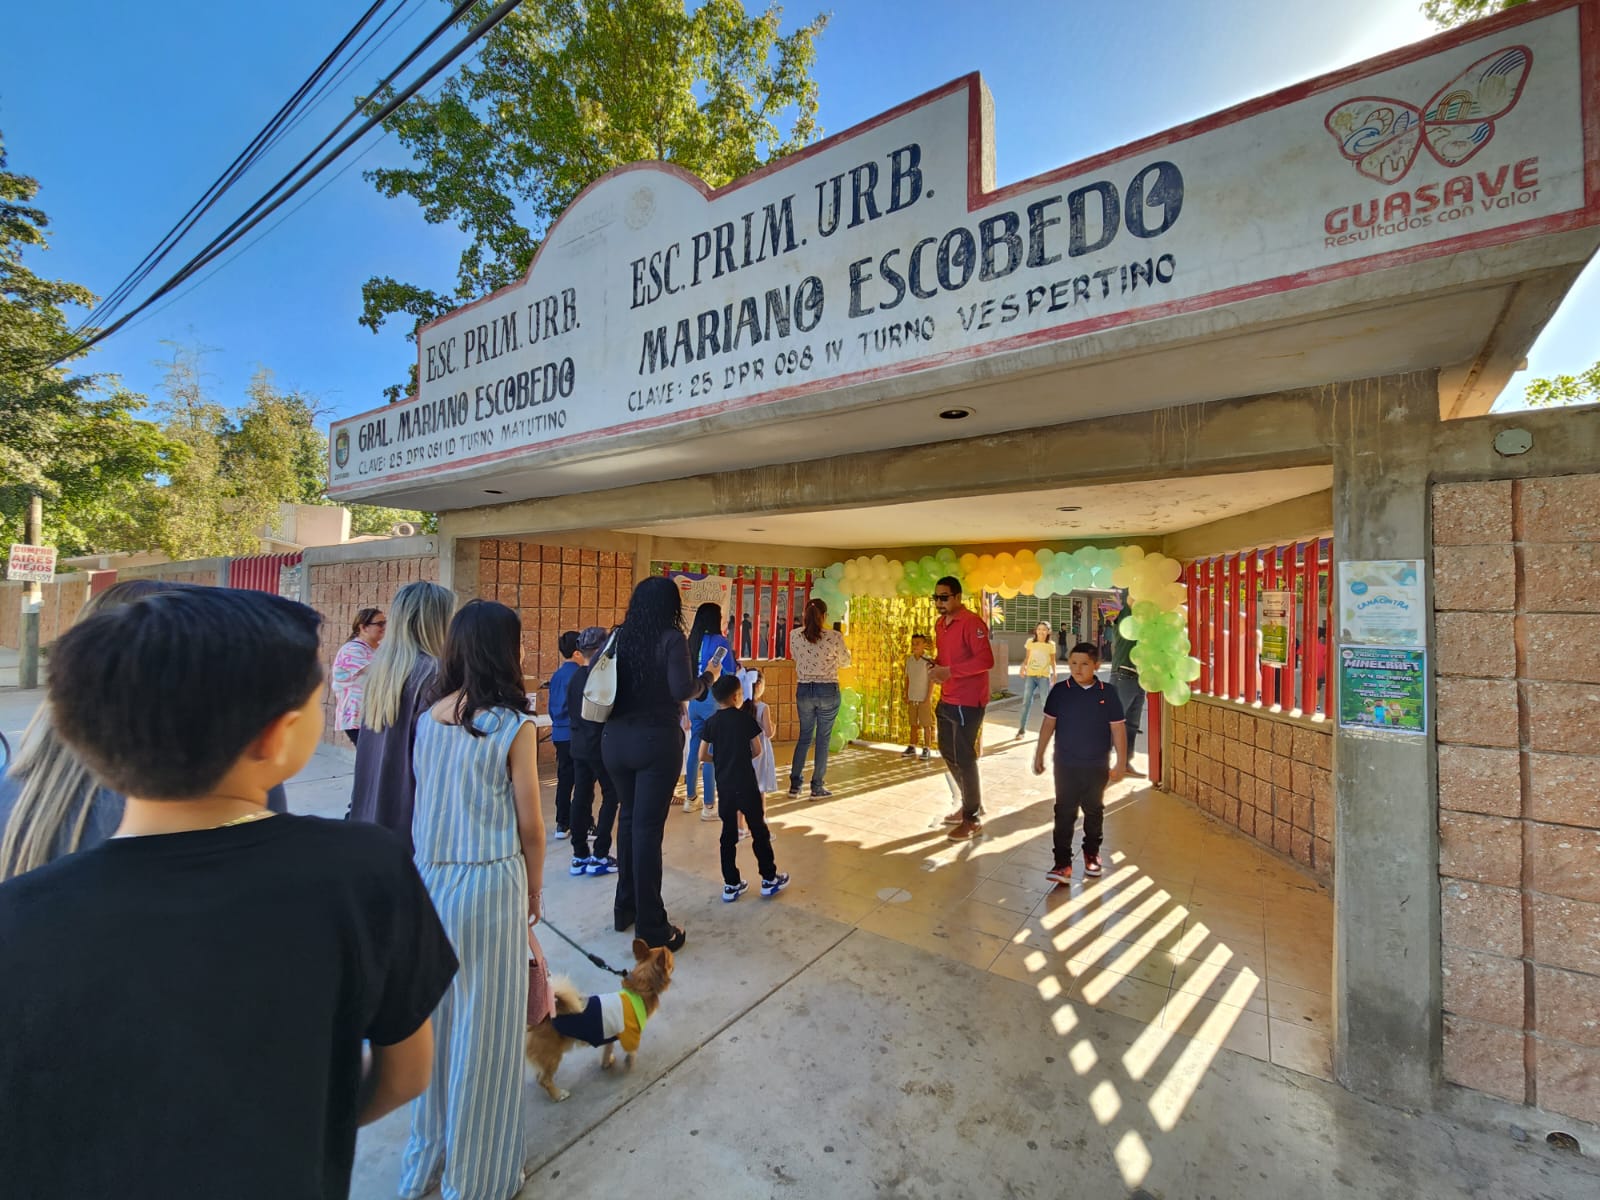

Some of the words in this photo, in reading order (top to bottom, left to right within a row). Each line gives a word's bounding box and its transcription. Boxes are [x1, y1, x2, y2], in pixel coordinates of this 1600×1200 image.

[629, 243, 685, 311] ESC.
[690, 193, 807, 287] PRIM.
[814, 142, 935, 237] URB.
[1323, 156, 1540, 235] GUASAVE
[1324, 211, 1433, 249] Resultados
[1437, 204, 1474, 223] con
[639, 275, 825, 376] MARIANO
[848, 160, 1185, 319] ESCOBEDO
[425, 337, 459, 383] ESC.
[463, 311, 524, 369] PRIM.
[528, 287, 581, 345] URB.
[627, 381, 683, 413] CLAVE:
[690, 371, 713, 398] 25
[723, 357, 764, 391] DPR
[774, 345, 814, 376] 098
[858, 315, 936, 356] TURNO
[956, 252, 1177, 333] VESPERTINO
[358, 418, 393, 453] GRAL.
[397, 391, 469, 444] MARIANO
[475, 357, 576, 422] ESCOBEDO
[389, 451, 403, 469] 25
[460, 428, 494, 453] TURNO
[501, 409, 567, 441] MATUTINO
[11, 554, 53, 565] AIRES
[11, 563, 52, 572] VIEJOS
[1343, 659, 1420, 672] MINECRAFT
